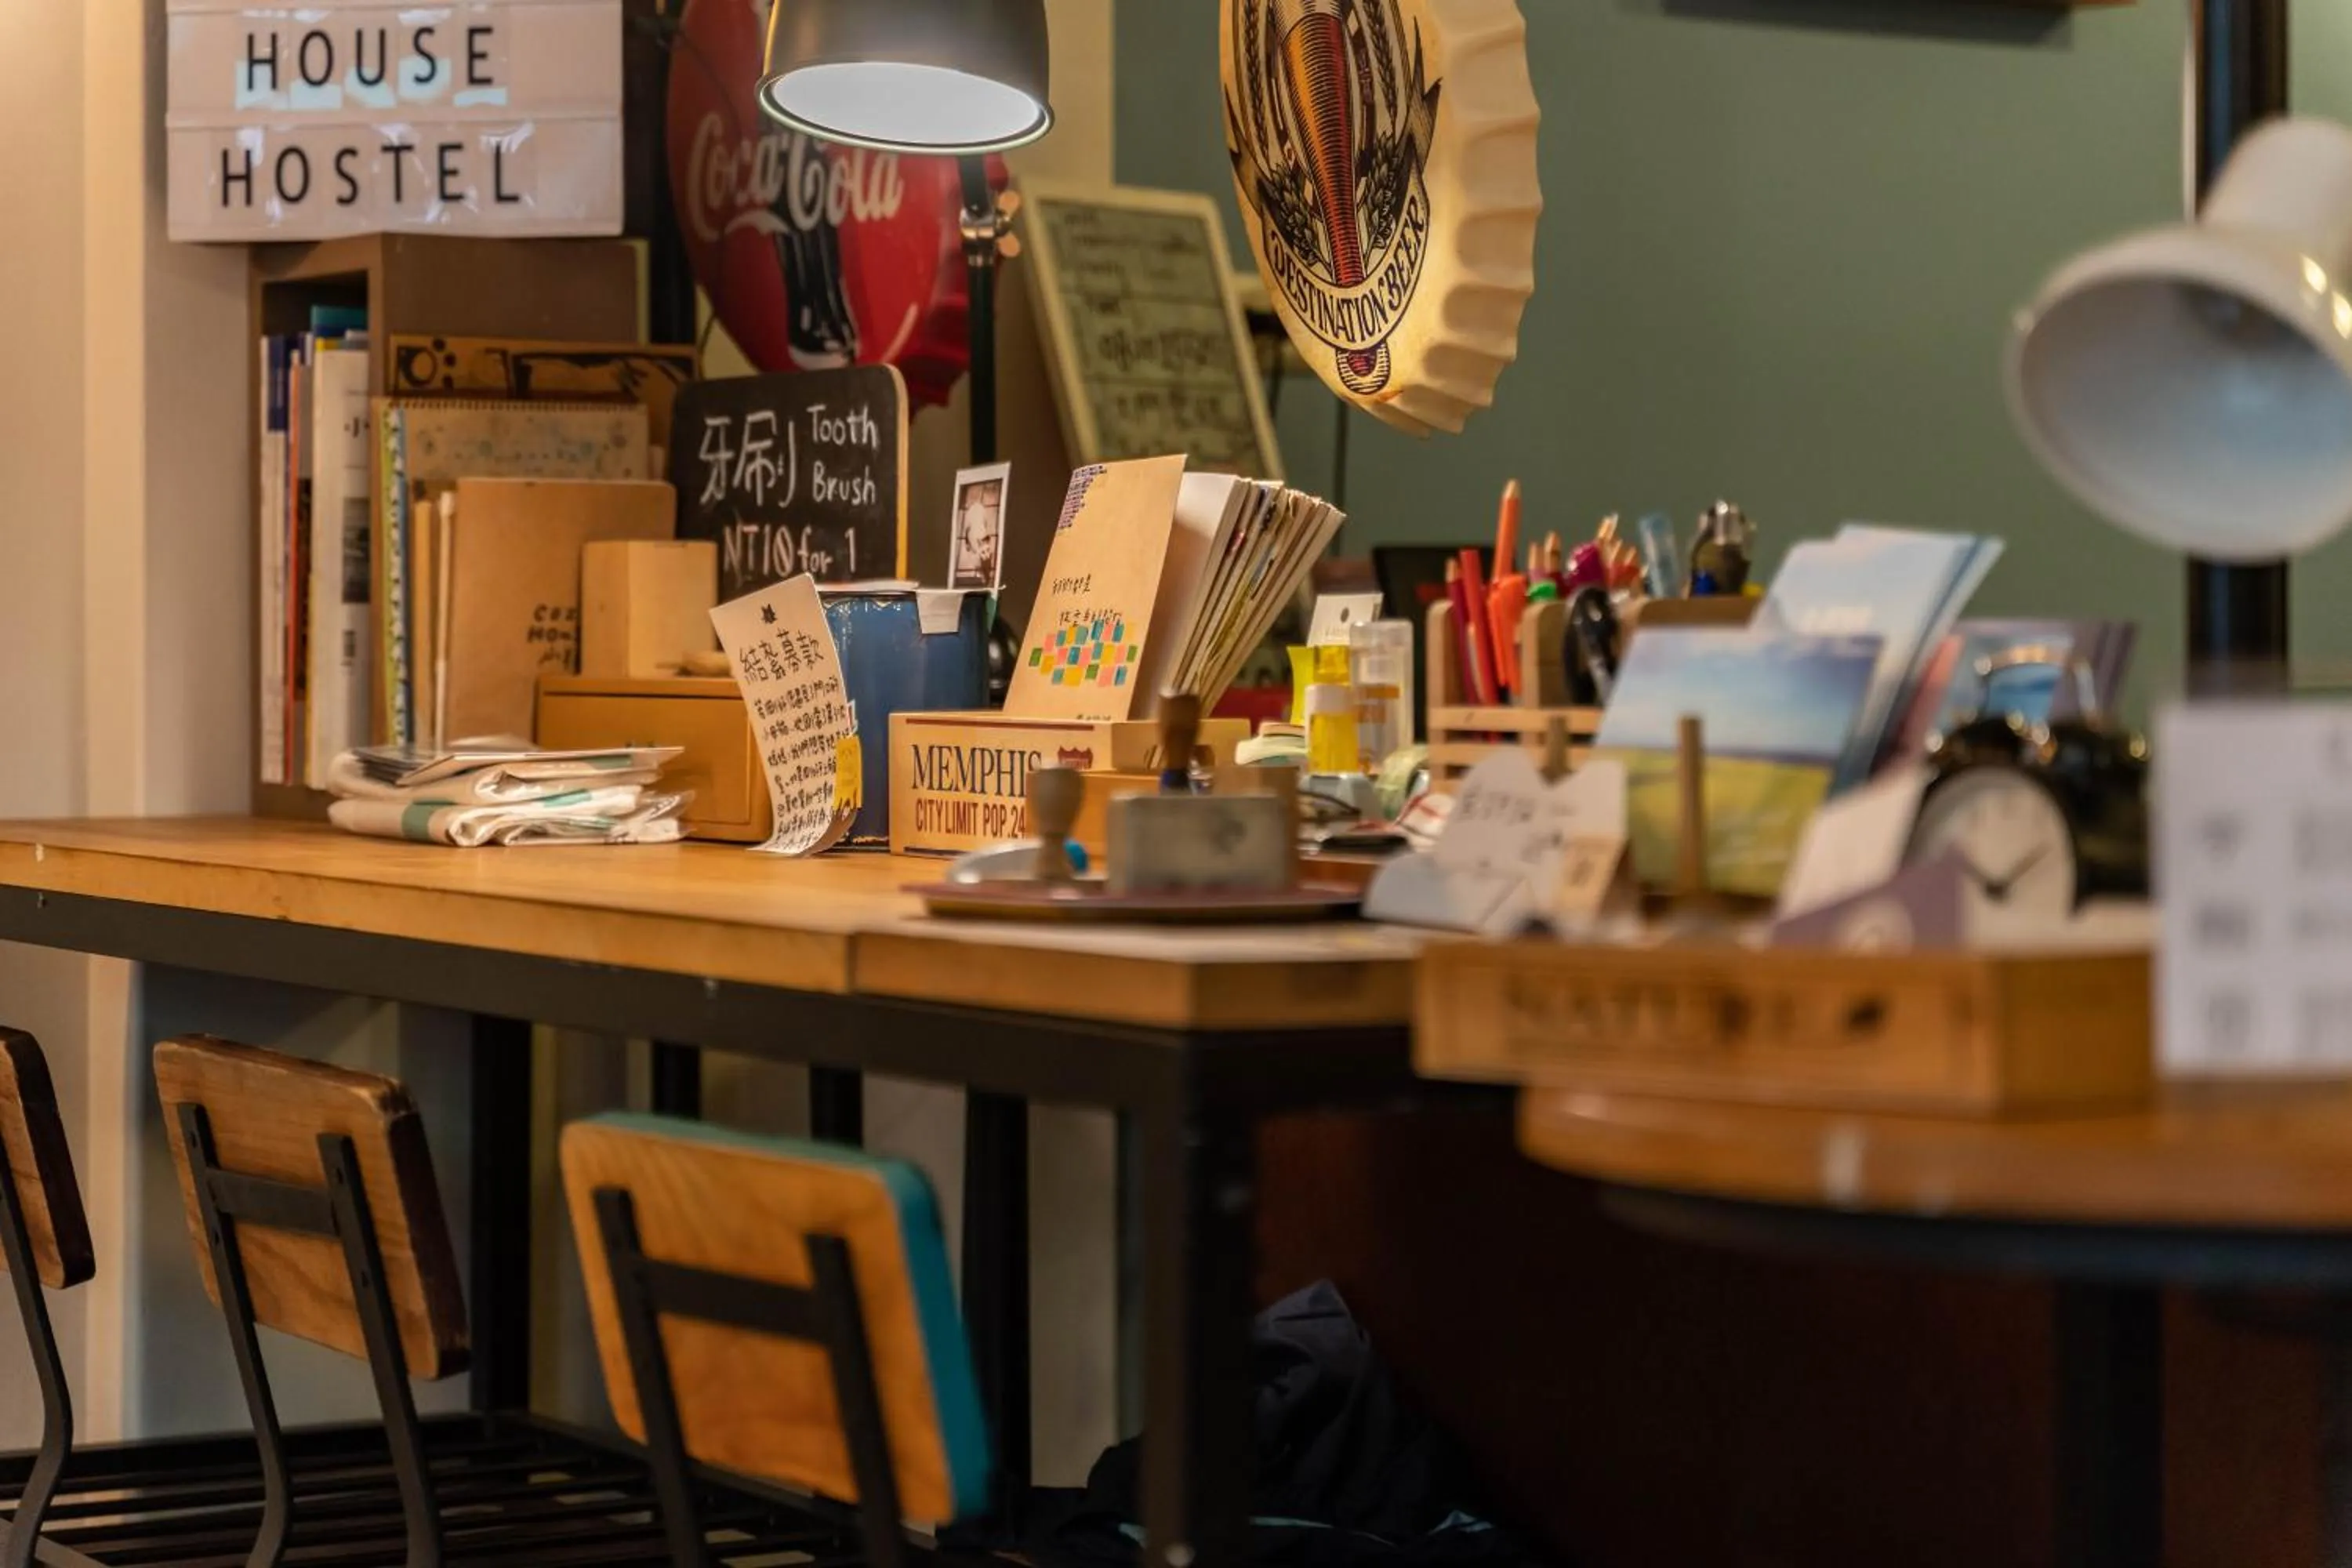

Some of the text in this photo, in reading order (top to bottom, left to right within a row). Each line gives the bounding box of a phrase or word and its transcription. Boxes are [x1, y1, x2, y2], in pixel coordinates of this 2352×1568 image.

[246, 26, 494, 92] HOUSE
[221, 142, 521, 206] HOSTEL
[1270, 234, 1388, 343] DESTINATION
[1385, 196, 1425, 311] BEER
[699, 409, 797, 508] 牙刷
[806, 403, 880, 451] Tooth
[811, 461, 877, 506] Brush
[797, 524, 833, 574] for
